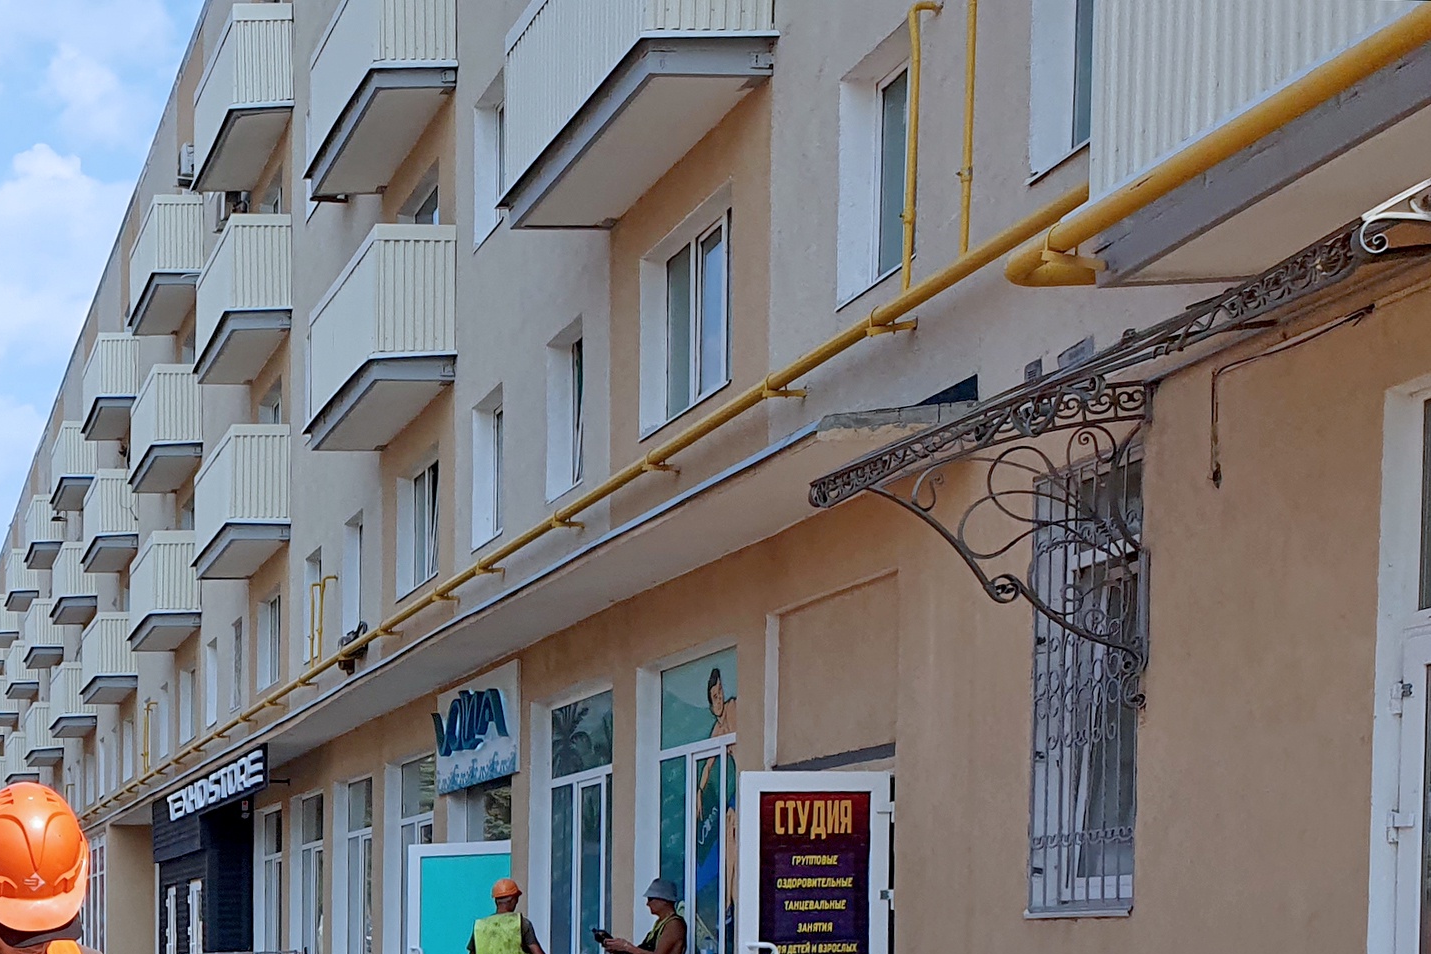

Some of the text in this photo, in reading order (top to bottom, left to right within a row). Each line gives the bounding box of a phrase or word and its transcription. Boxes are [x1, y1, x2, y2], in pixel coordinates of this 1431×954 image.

[774, 799, 852, 840] СТУДИЯ
[791, 854, 839, 866] ГРУППОВЫЕ
[776, 877, 854, 889] ОЗДОРОВИТЕЛЬНЫЕ
[783, 899, 847, 912] ТАНЦЕВАЛЬНЫЕ
[796, 922, 834, 934] ЗАНЯТИЯ
[787, 941, 811, 954] ДЕТЕЙ
[818, 942, 857, 953] ВЗРОСЛЫХ
